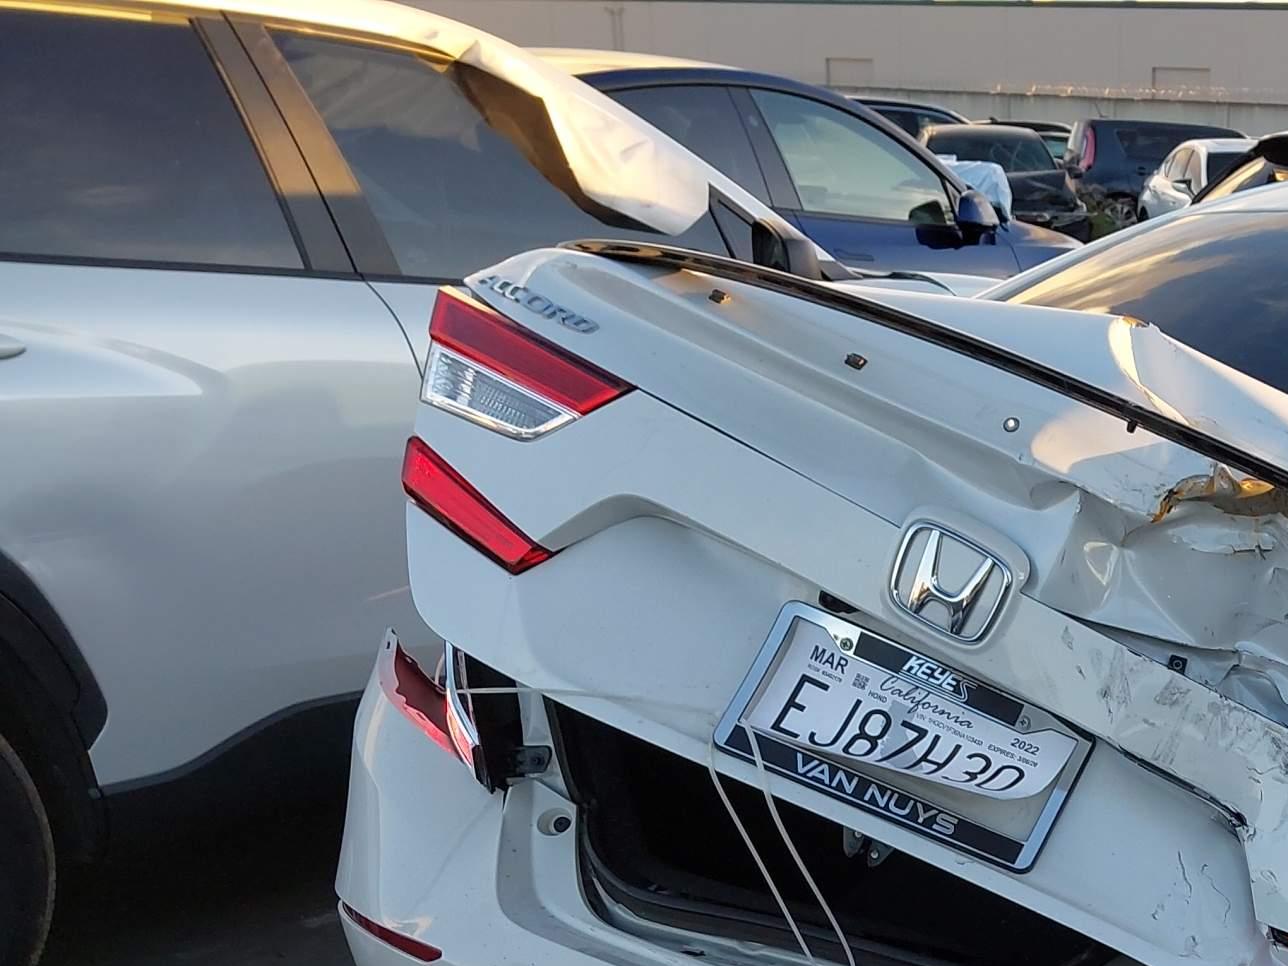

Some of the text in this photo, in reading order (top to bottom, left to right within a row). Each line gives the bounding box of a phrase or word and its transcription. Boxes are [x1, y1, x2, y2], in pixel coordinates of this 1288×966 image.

[478, 275, 601, 335] ACCORD
[809, 644, 849, 675] MAR
[902, 655, 978, 703] KEYES
[867, 690, 888, 703] HOND
[879, 674, 975, 729] California
[1010, 738, 1040, 756] 2022
[796, 752, 959, 835] VAN NUYS
